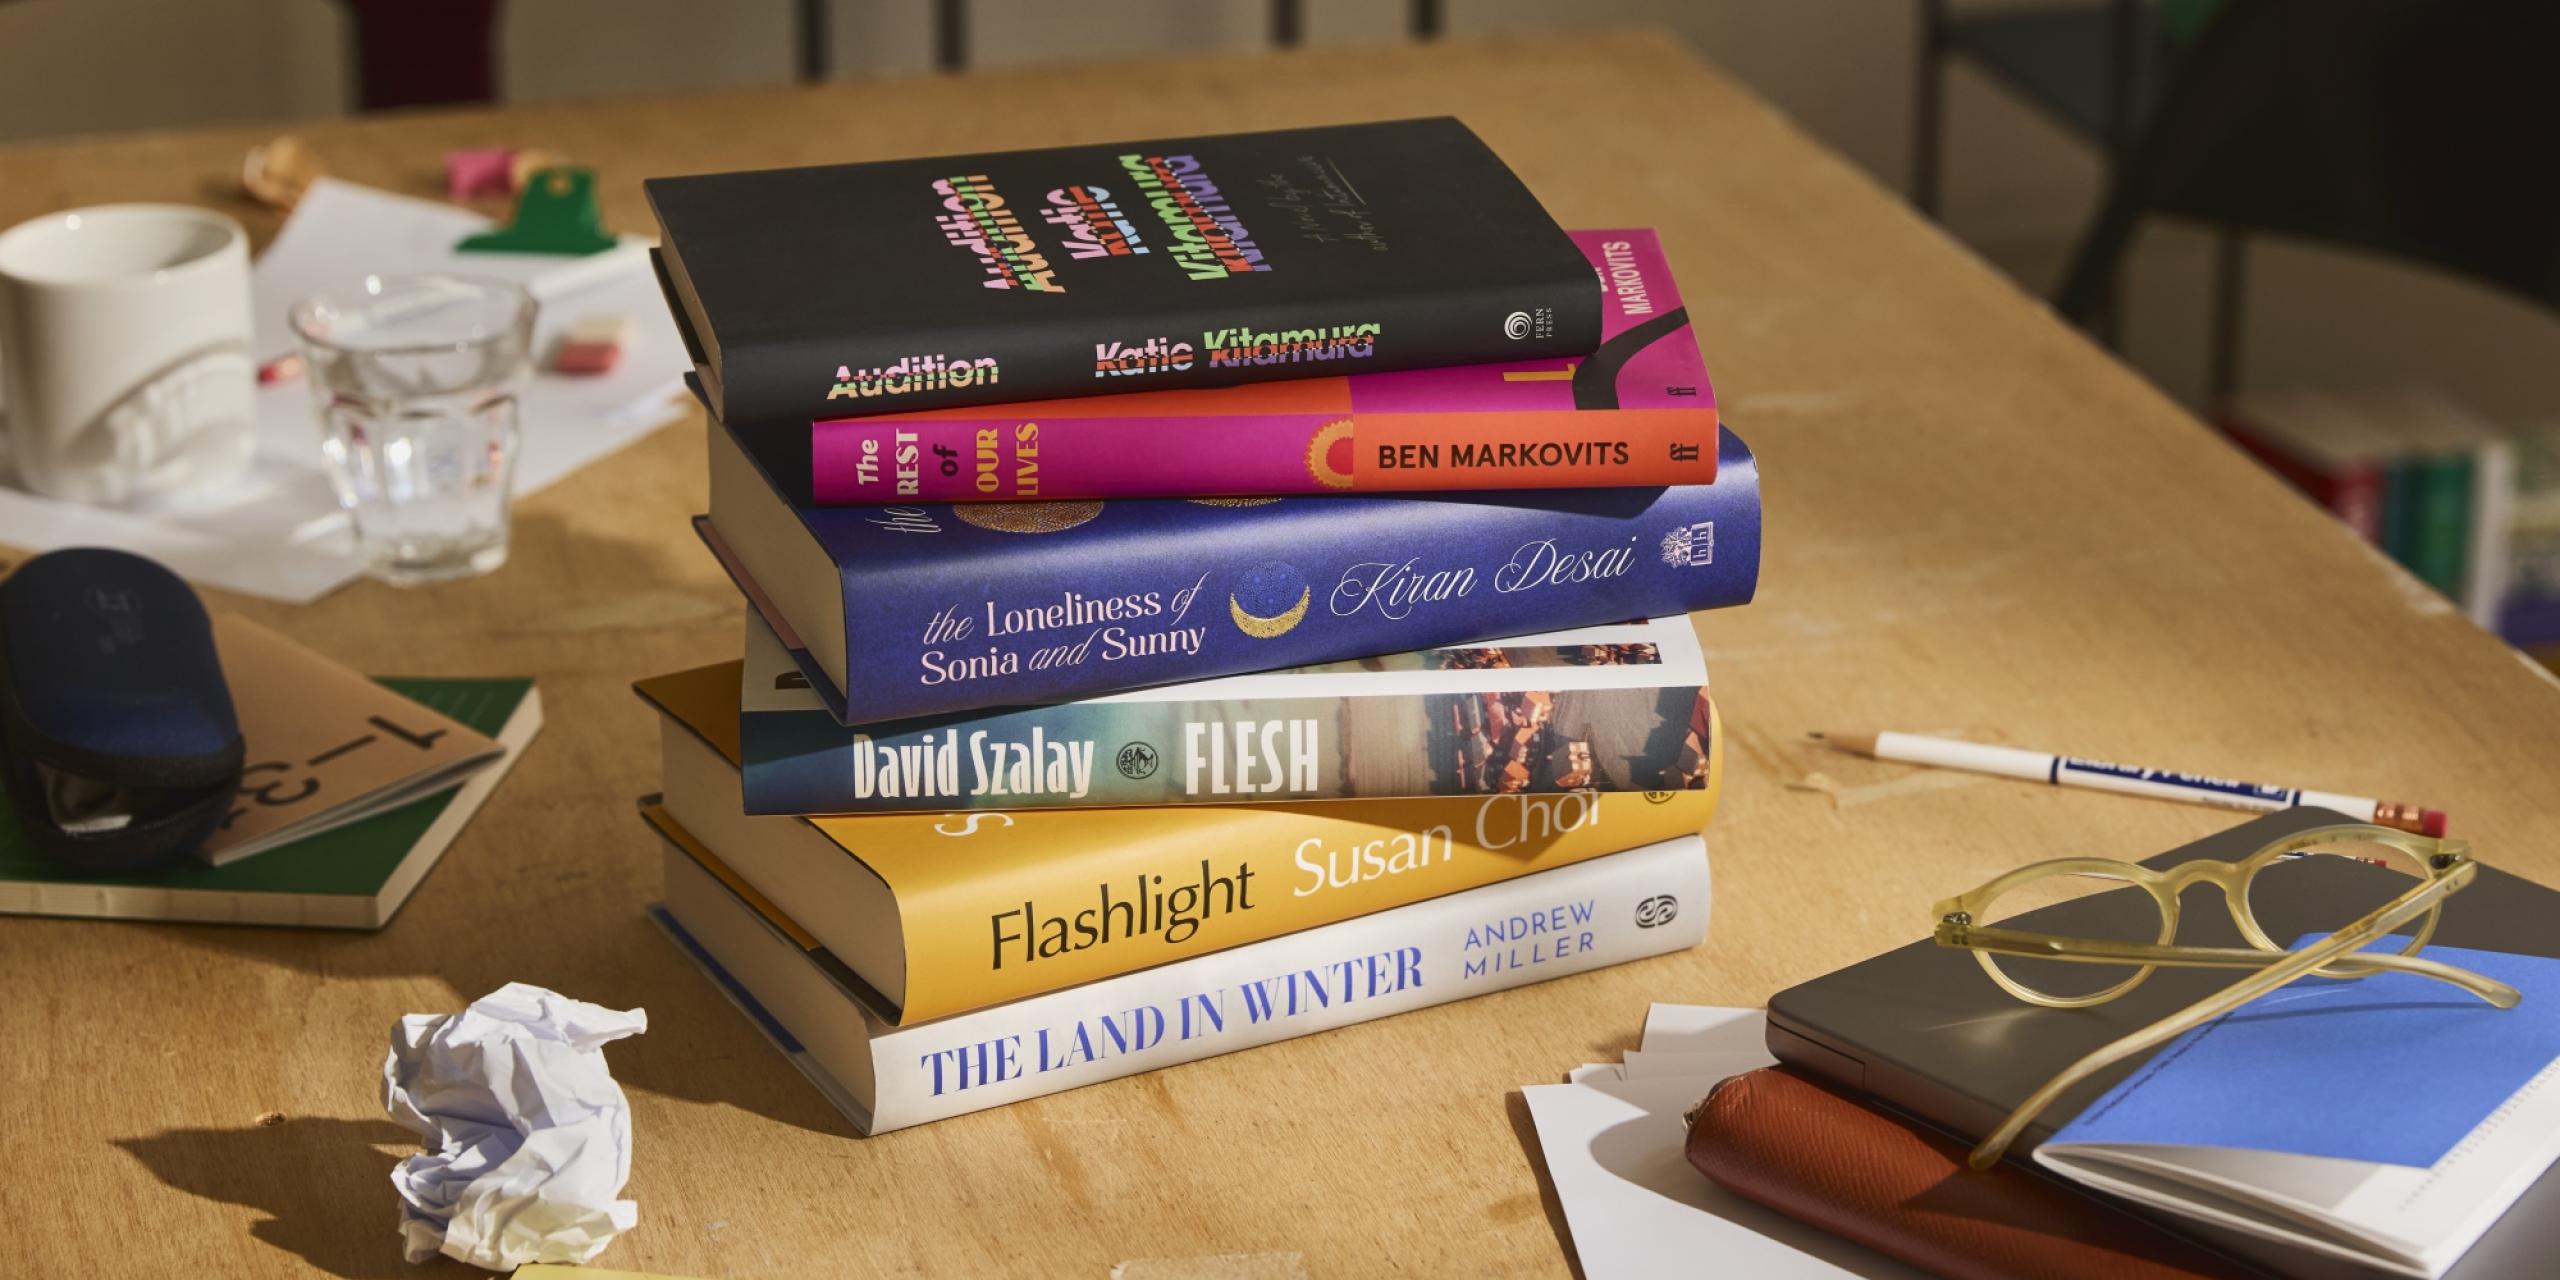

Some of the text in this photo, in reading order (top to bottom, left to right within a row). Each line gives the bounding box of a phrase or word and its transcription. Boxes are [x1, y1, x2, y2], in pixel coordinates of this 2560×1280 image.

[1602, 240, 1653, 316] MARKOVITS
[1535, 308, 1545, 339] FERN
[827, 321, 1381, 400] Audition Katie Kitamura
[856, 439, 879, 486] The
[896, 428, 919, 495] REST
[933, 443, 959, 477] of
[976, 428, 999, 493] OUR
[1016, 422, 1039, 496] LIVES
[1378, 441, 1629, 468] BEN MARKOVITS
[923, 569, 1213, 646] the Loneliness of
[1330, 535, 1638, 620] Kiran Desai
[920, 627, 1206, 685] Sonia and Sunny
[853, 726, 1095, 799] David Szalay
[1185, 719, 1319, 795] FLESH
[990, 859, 1256, 971] Flashlight
[1292, 824, 1454, 899] Susan
[1464, 900, 1596, 952] ANDREW
[1464, 931, 1596, 980] MILLER
[920, 945, 1424, 1098] THE LAND IN WINTER
